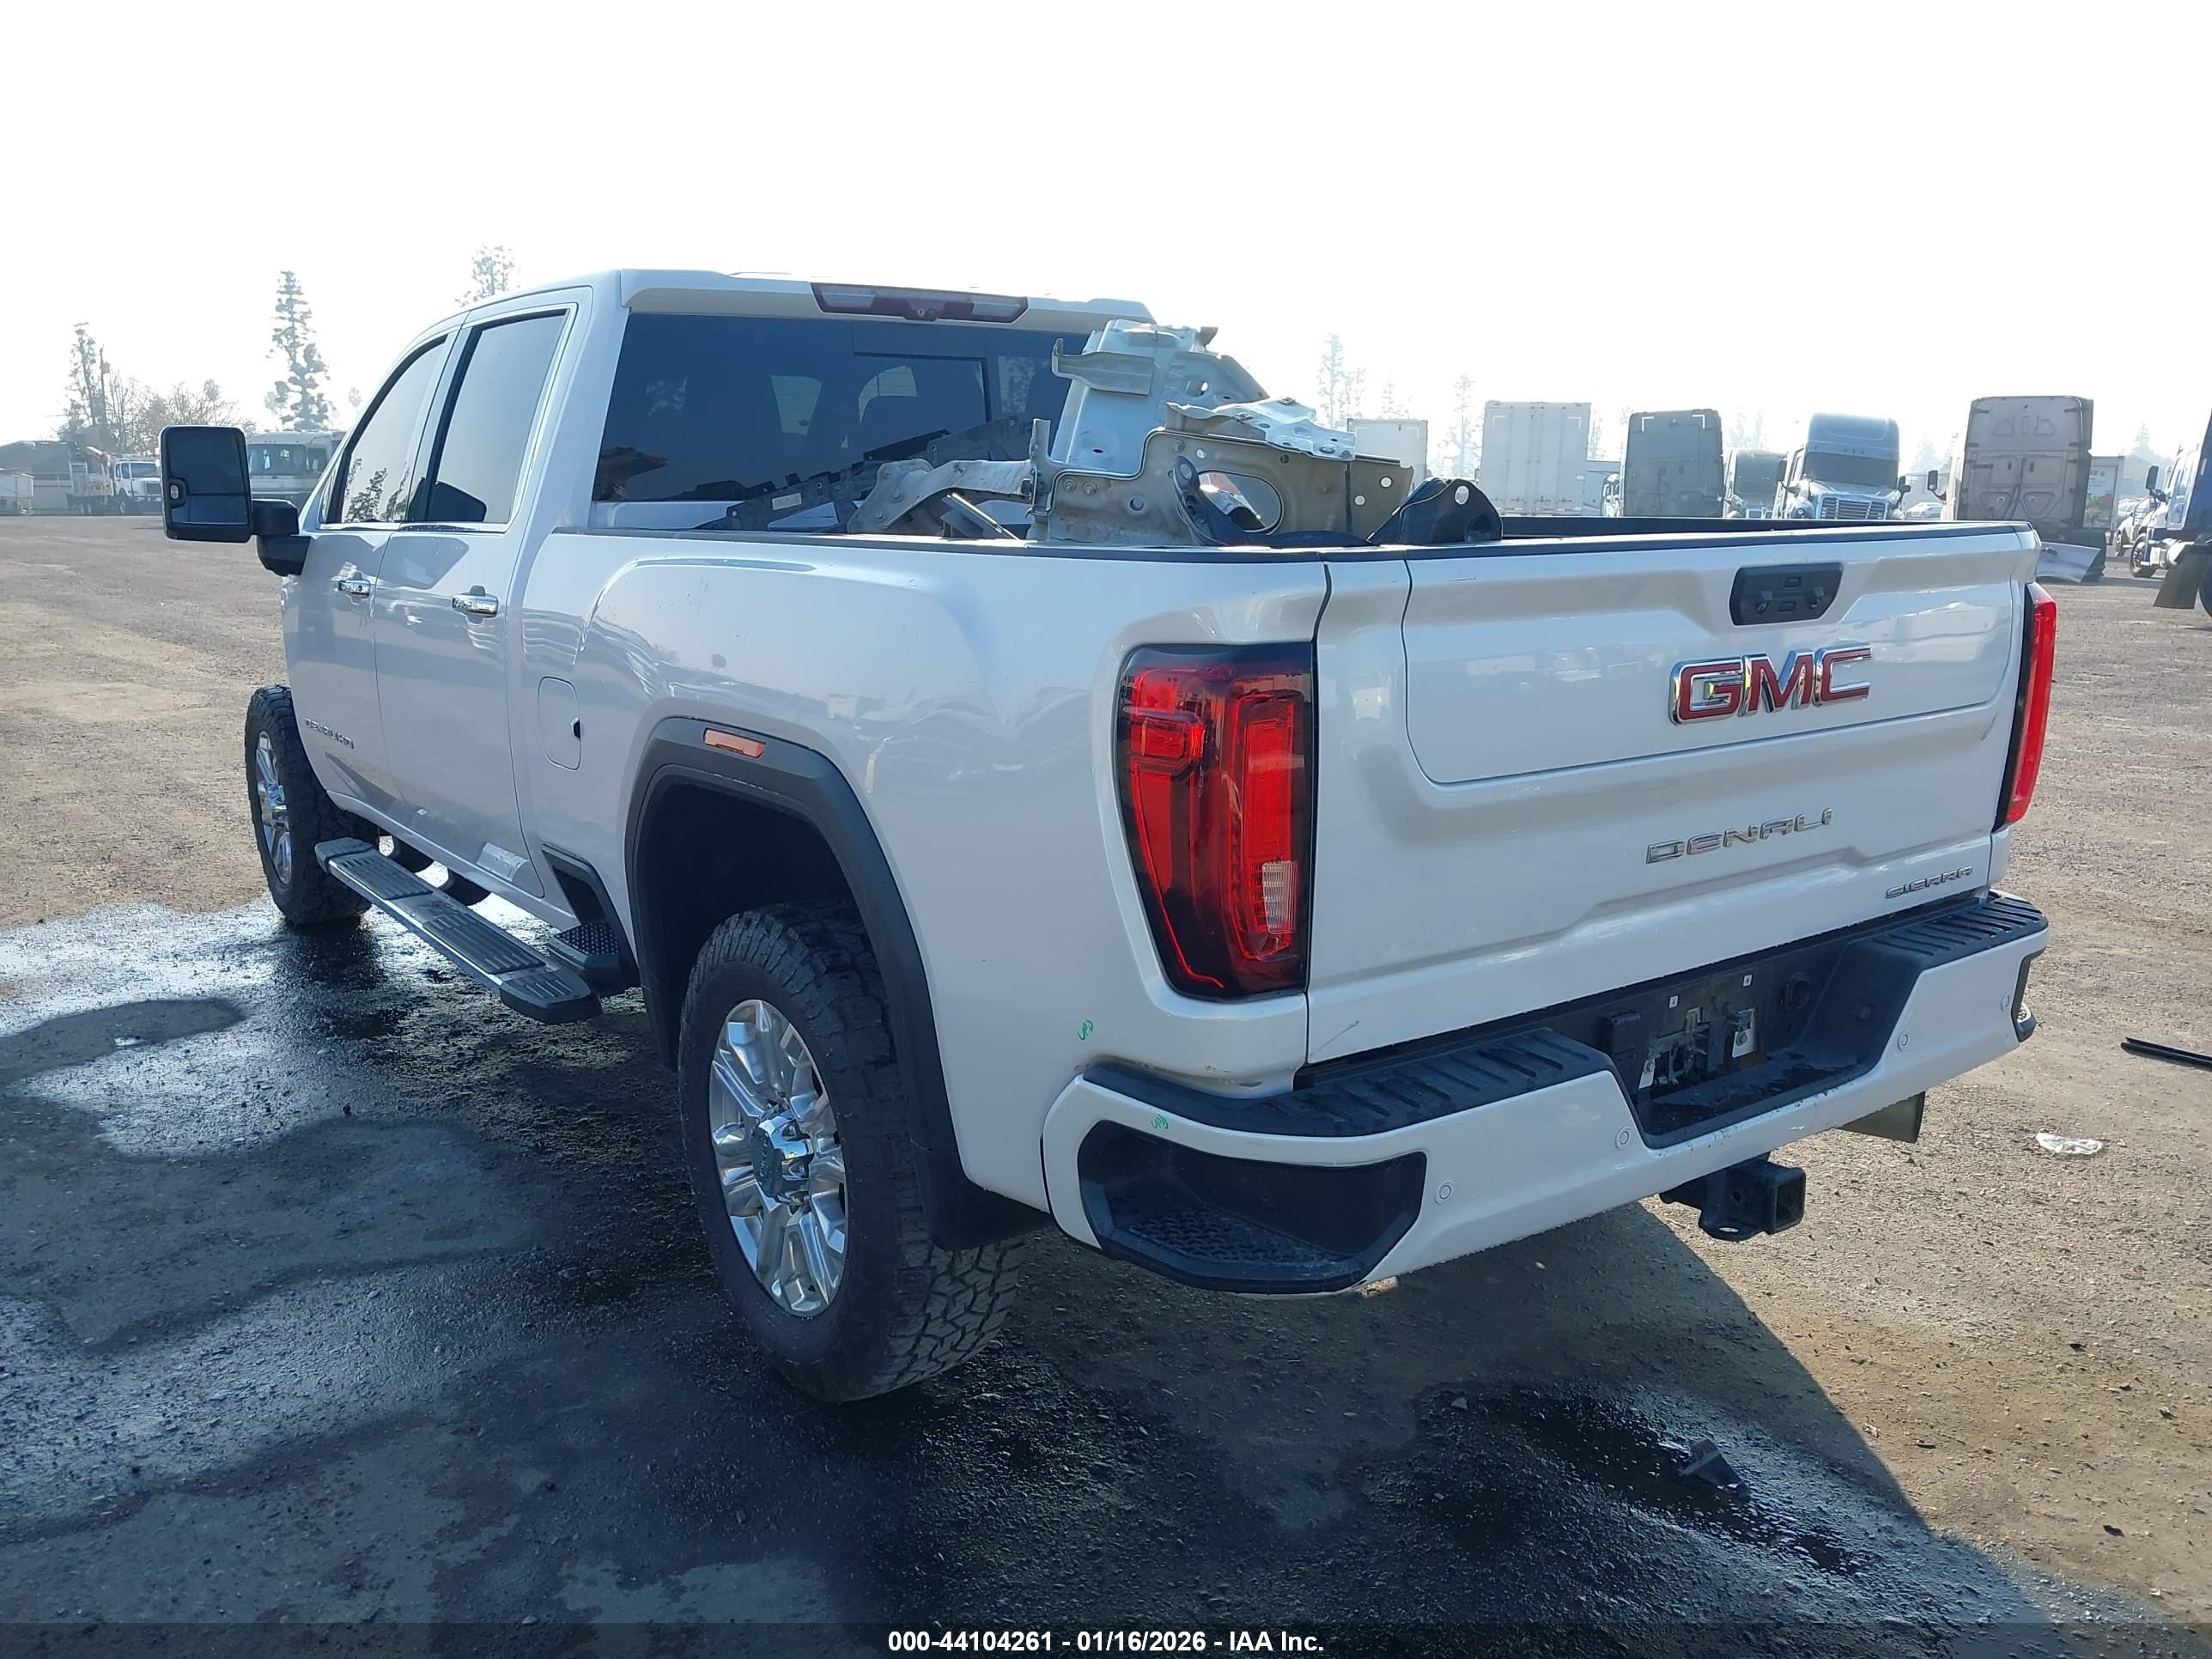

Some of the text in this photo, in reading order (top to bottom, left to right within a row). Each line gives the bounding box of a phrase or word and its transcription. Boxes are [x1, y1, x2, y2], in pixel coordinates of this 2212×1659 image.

[1668, 642, 1873, 726] GMC
[1645, 807, 1833, 865] DENALI
[1885, 866, 1973, 899] SIERRA
